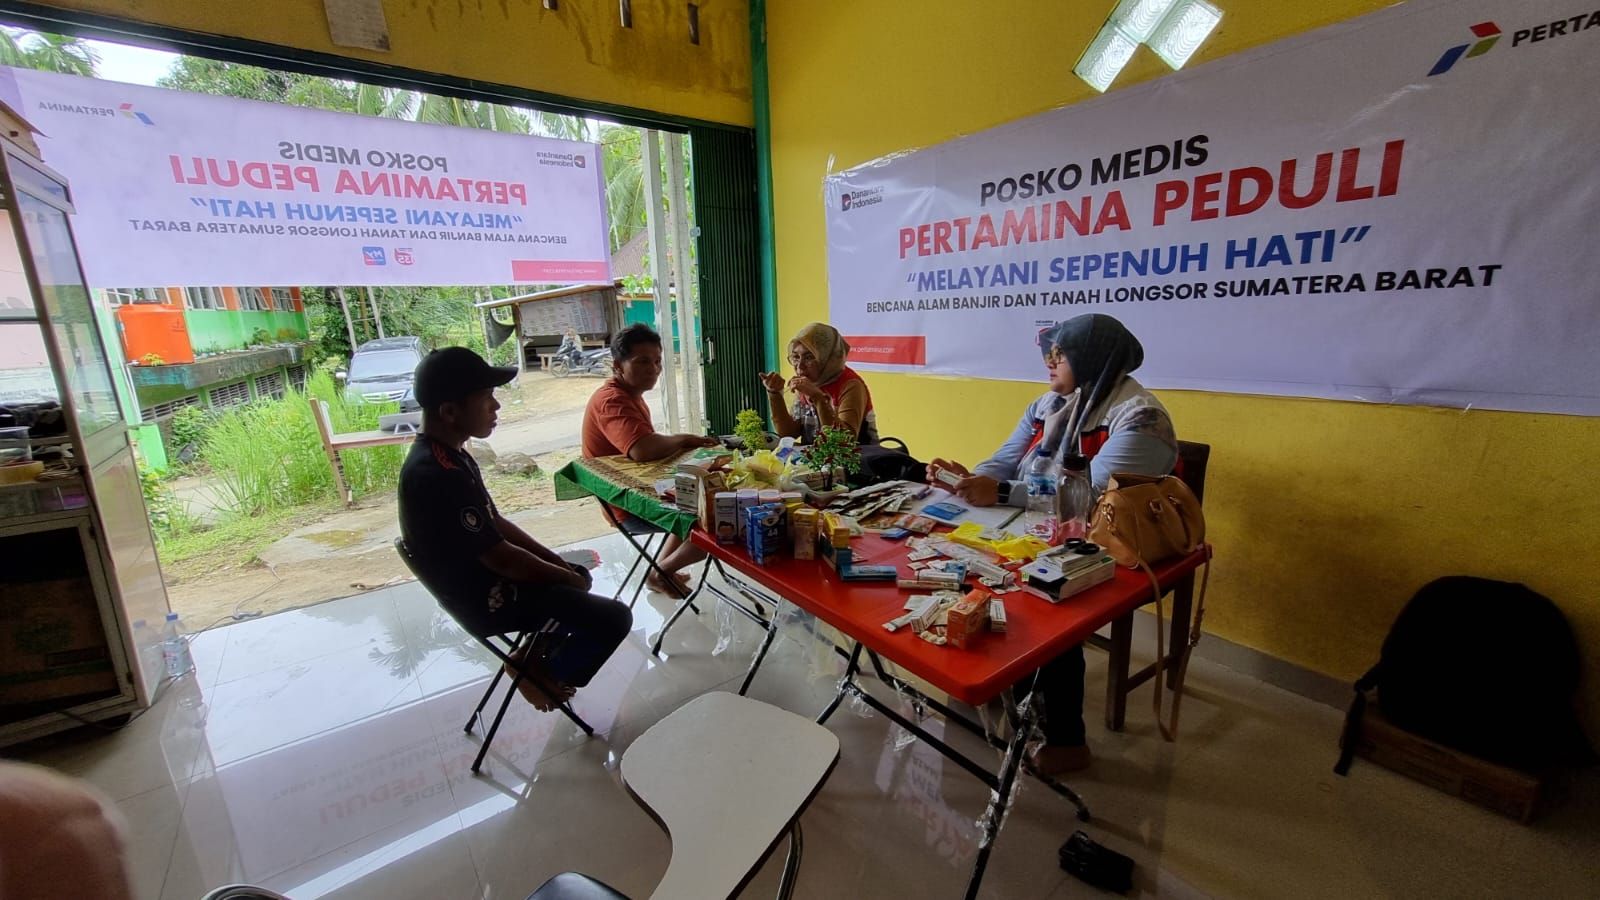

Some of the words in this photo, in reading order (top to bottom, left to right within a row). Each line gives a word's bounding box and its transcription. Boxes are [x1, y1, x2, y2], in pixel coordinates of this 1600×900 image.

[899, 190, 1132, 260] PERTAMINA
[1152, 139, 1405, 227] PEDULI
[981, 163, 1082, 207] POSKO
[1090, 134, 1209, 186] MEDIS
[866, 301, 915, 313] BENCANA
[917, 297, 950, 311] ALAM
[952, 295, 1001, 309] BANJIR
[1003, 292, 1037, 308] DAN
[1040, 288, 1101, 305] TANAH
[1105, 281, 1208, 303] LONGSOR
[1213, 273, 1367, 299] SUMATERA
[1374, 264, 1502, 292] BARAT
[1049, 242, 1209, 283] SEPENUH
